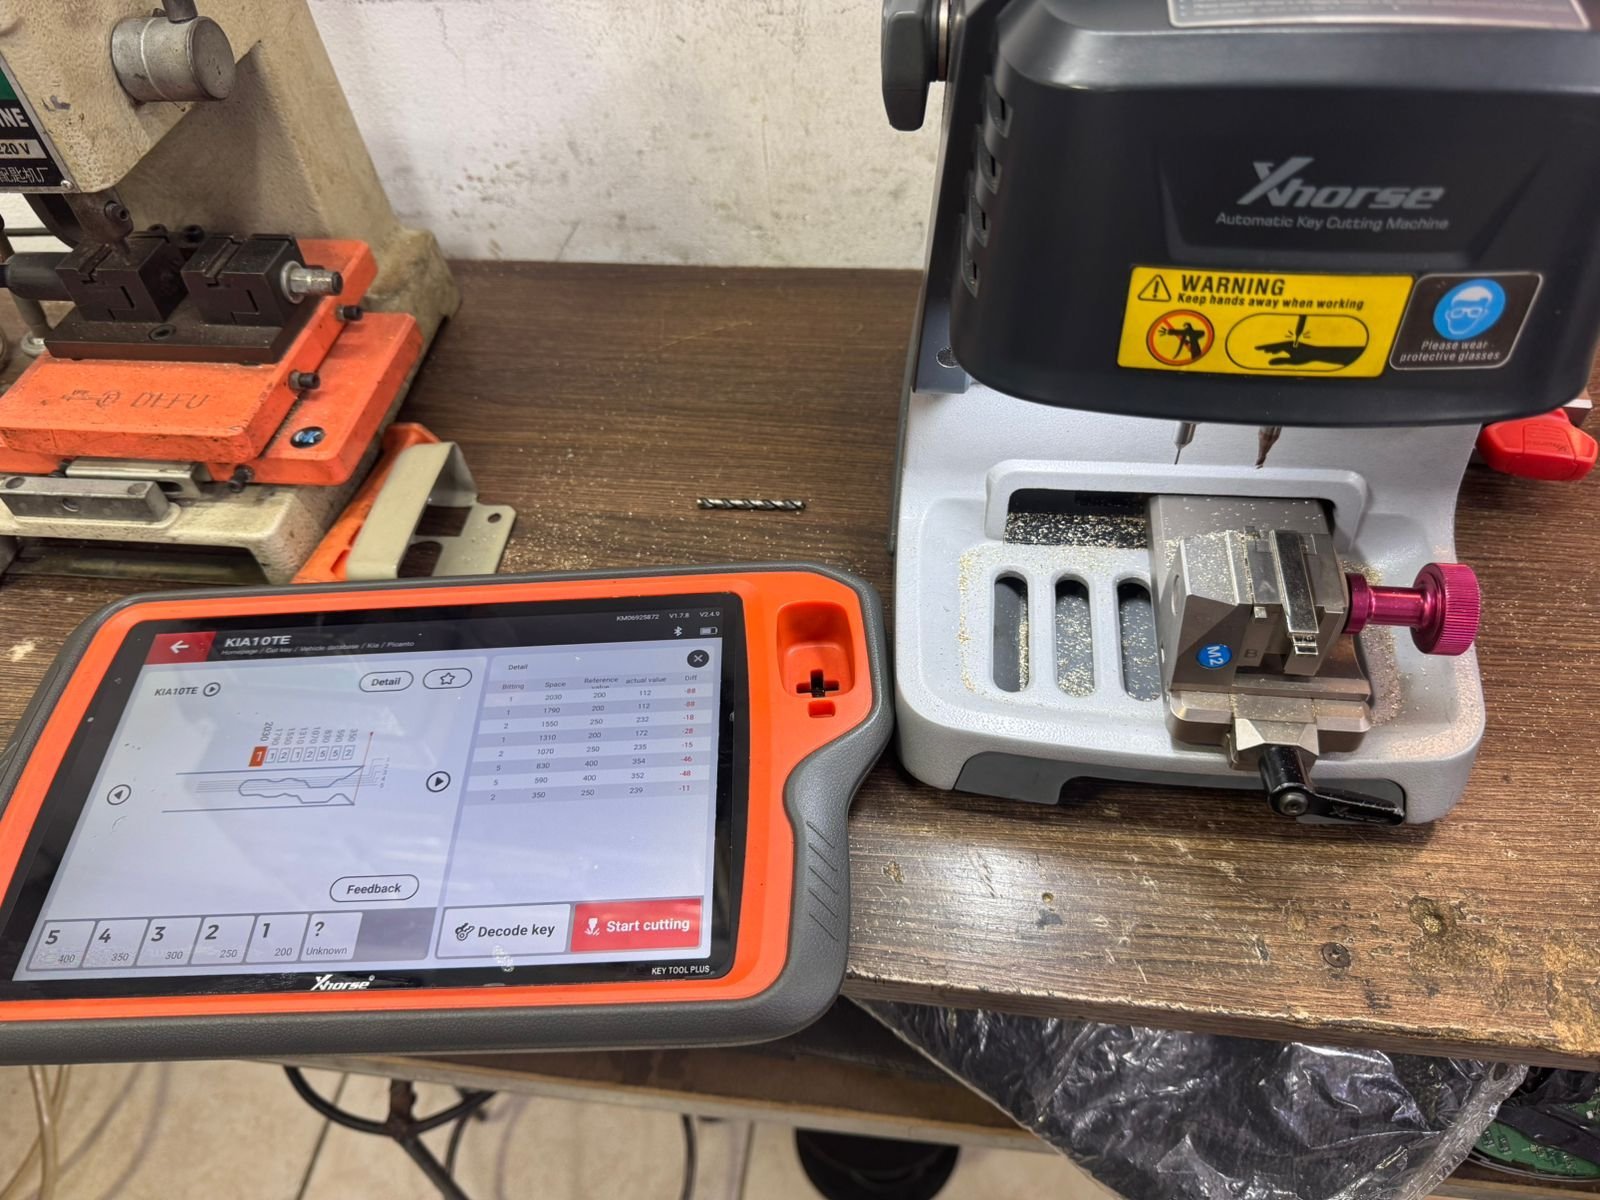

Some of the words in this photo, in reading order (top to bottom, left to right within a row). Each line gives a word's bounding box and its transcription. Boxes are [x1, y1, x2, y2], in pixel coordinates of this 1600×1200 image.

[19, 143, 30, 154] V
[1236, 157, 1445, 209] Xhorse
[1216, 212, 1293, 228] Automatic
[1297, 215, 1324, 231] Key
[1326, 216, 1383, 232] Cutting
[1385, 217, 1449, 230] Machine
[1181, 274, 1286, 296] WARNING
[1177, 293, 1206, 306] Keep
[1209, 294, 1245, 306] hands
[1248, 297, 1279, 309] away
[1282, 297, 1314, 308] when
[1317, 298, 1364, 310] working
[1421, 341, 1458, 351] Please
[1461, 341, 1487, 350] wear
[1400, 351, 1457, 362] protective
[1458, 351, 1501, 362] glasses
[224, 635, 292, 648] KIA10TE
[1206, 645, 1225, 666] M2
[371, 677, 401, 686] Detail
[544, 681, 567, 689] Space
[154, 686, 198, 697] KIA10TE
[260, 721, 274, 742] 2030
[531, 791, 546, 799] 350
[347, 883, 402, 895] Feedback
[262, 923, 271, 938] 1
[314, 921, 325, 937] ?
[478, 925, 528, 938] Decode
[531, 924, 555, 937] key
[606, 920, 639, 933] Start
[643, 918, 690, 932] cutting
[45, 929, 61, 945] 5
[98, 928, 111, 943] 4
[151, 926, 166, 942] 3
[204, 924, 219, 940] 2
[111, 953, 129, 961] 350
[165, 951, 183, 960] 300
[219, 949, 237, 958] 250
[274, 947, 293, 957] 200
[306, 946, 347, 956] Unknown
[58, 954, 76, 963] 400
[651, 966, 667, 975] KEY
[668, 965, 689, 974] TOOL
[690, 965, 710, 974] PLUS
